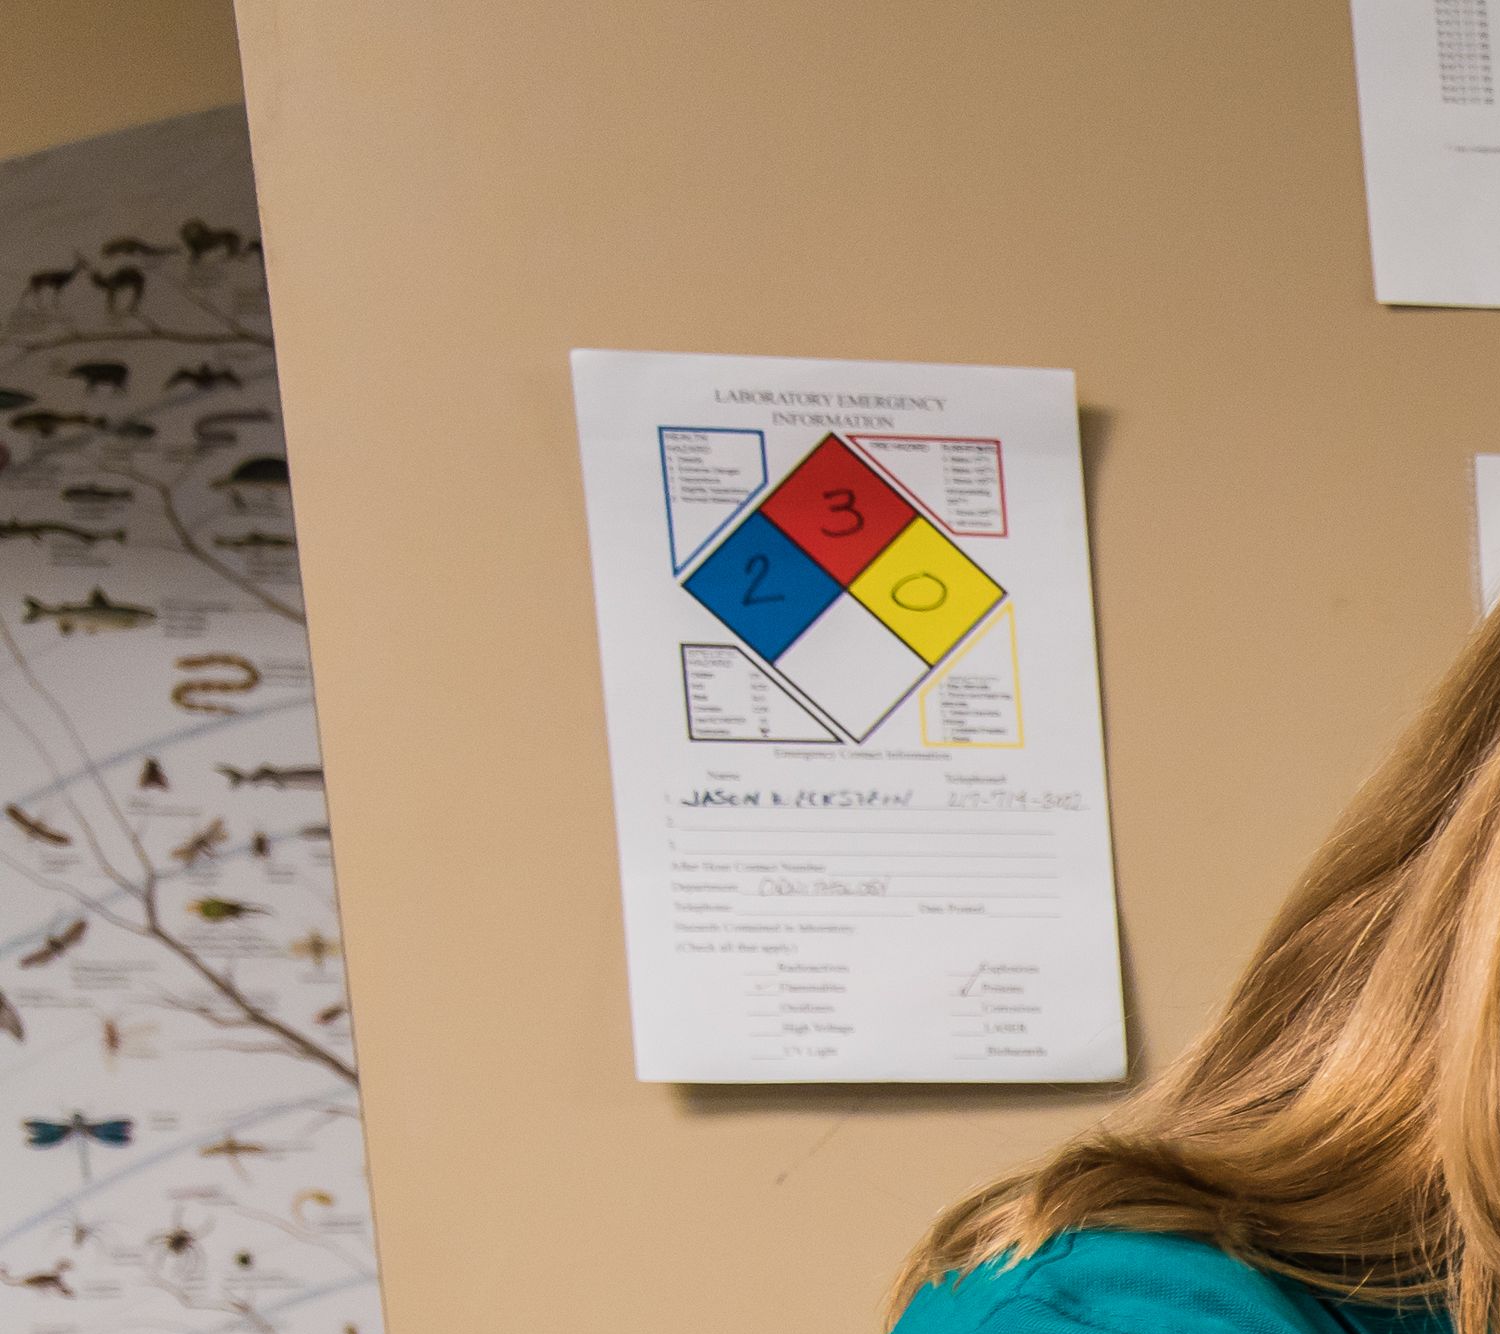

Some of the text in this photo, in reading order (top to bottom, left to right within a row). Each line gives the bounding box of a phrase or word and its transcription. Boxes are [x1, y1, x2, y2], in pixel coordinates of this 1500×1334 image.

[714, 389, 947, 412] LABORATORY EMERGENCY
[772, 413, 894, 430] INFORMATION
[820, 487, 865, 538] 3
[738, 551, 785, 606] 2
[891, 572, 947, 612] 0
